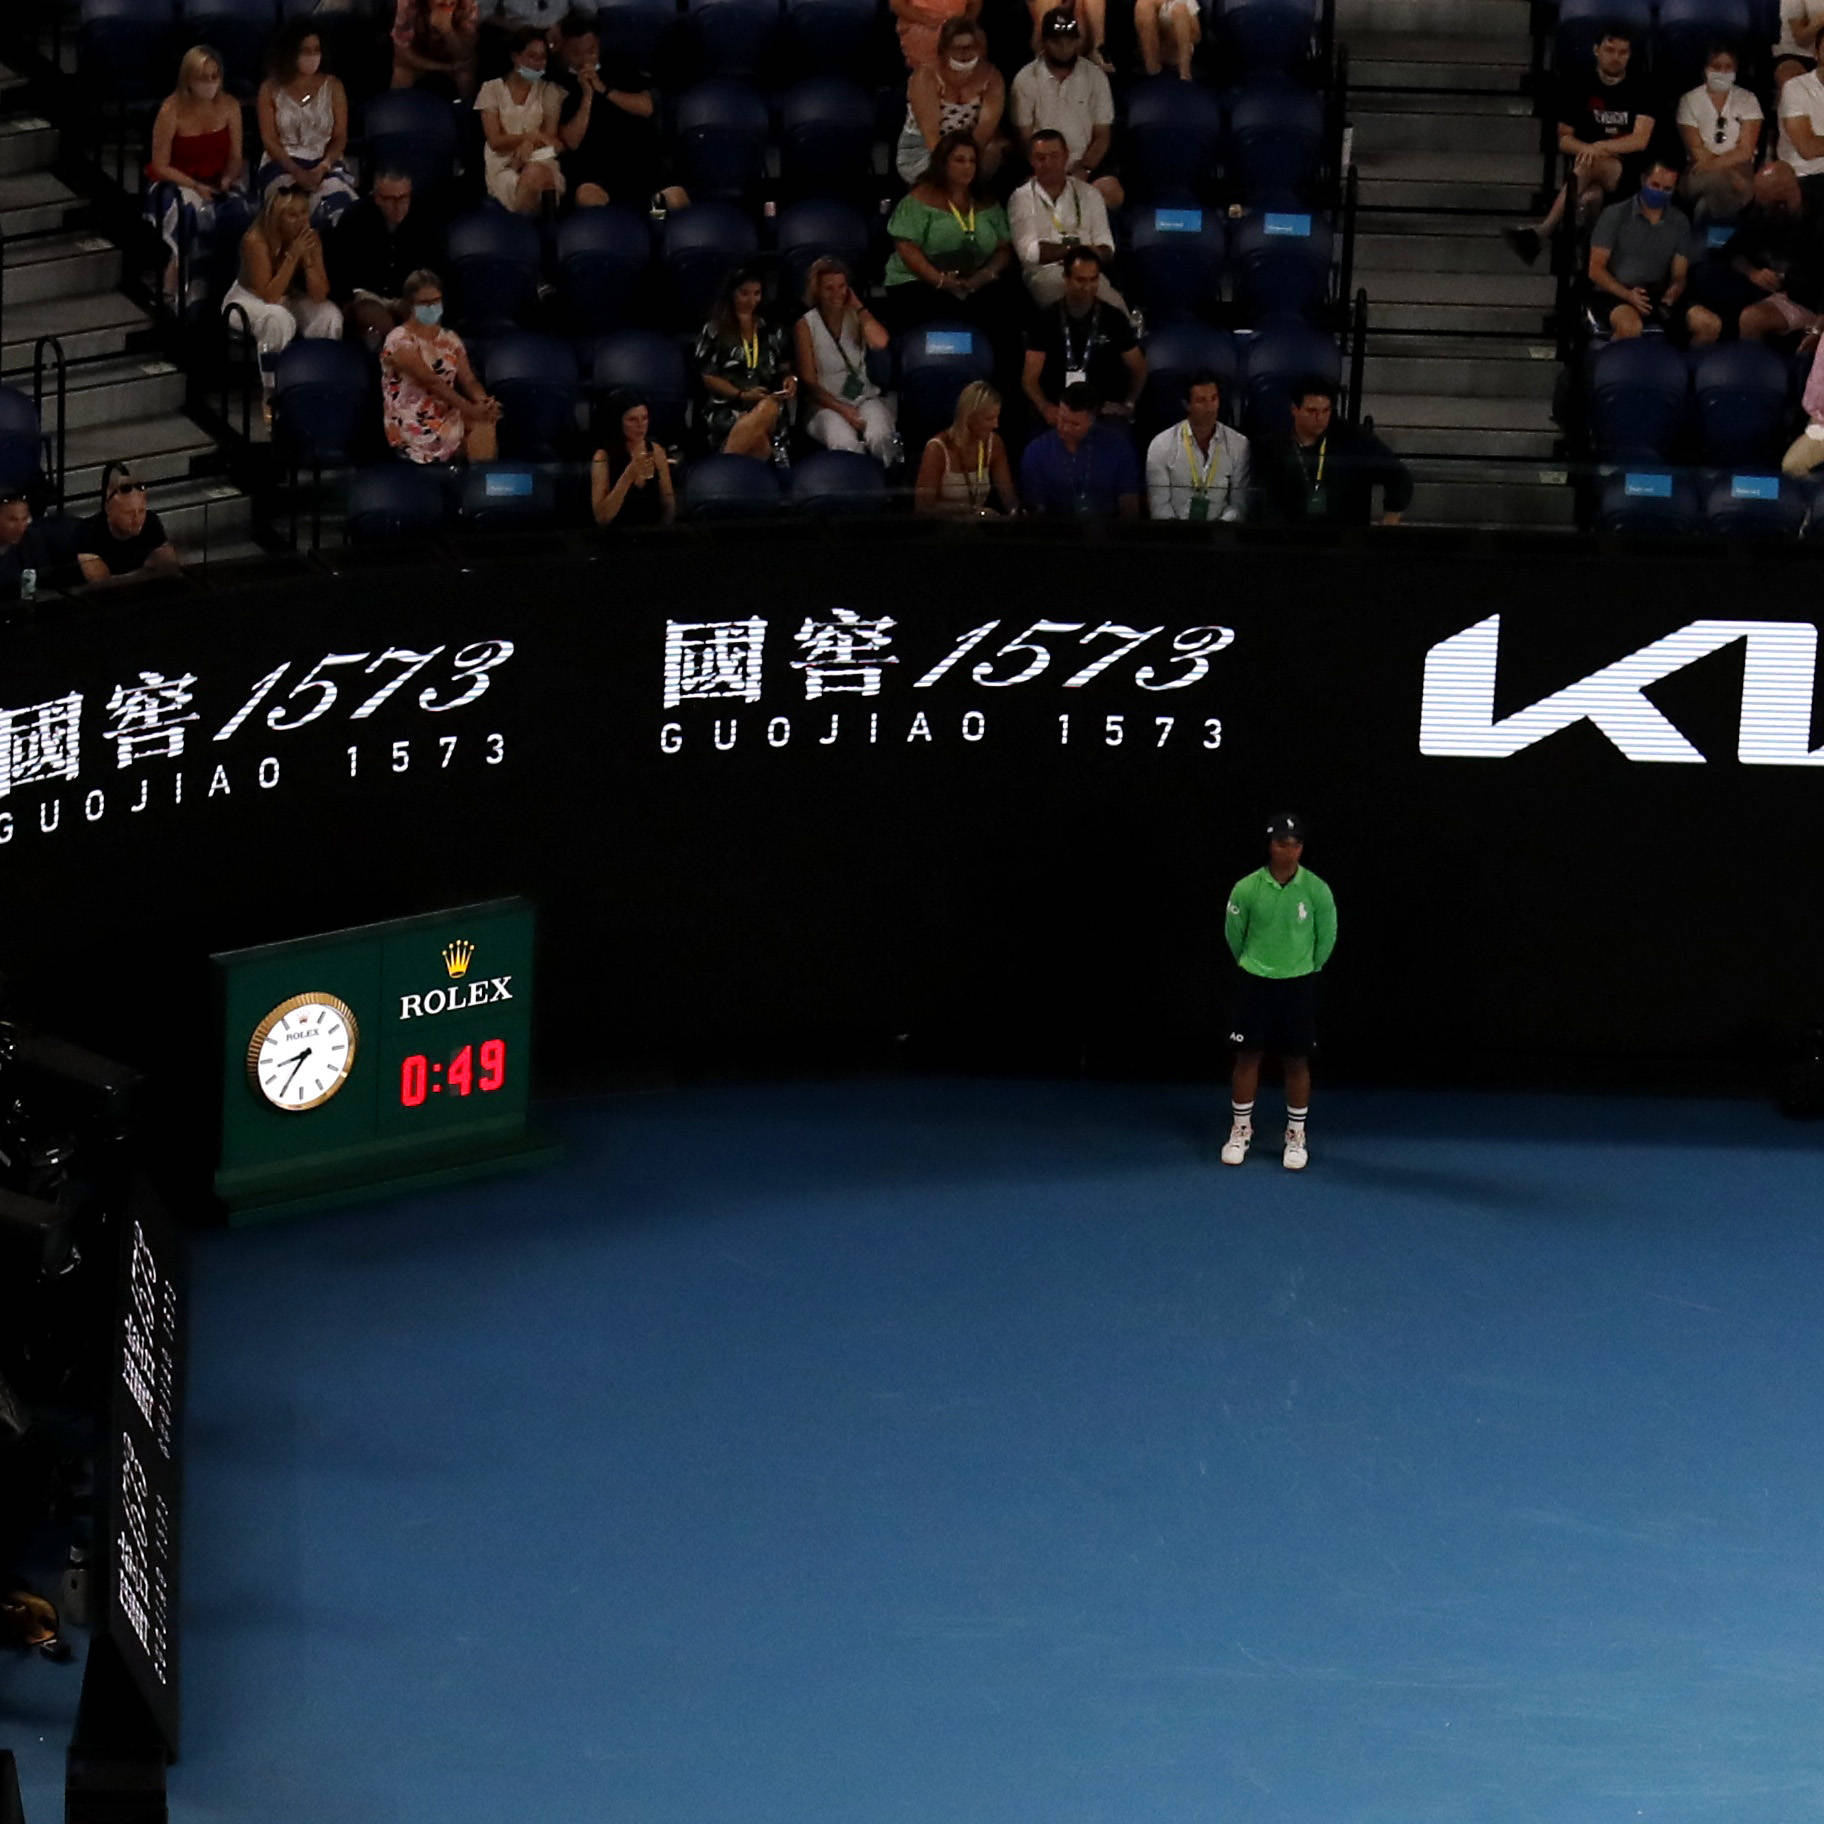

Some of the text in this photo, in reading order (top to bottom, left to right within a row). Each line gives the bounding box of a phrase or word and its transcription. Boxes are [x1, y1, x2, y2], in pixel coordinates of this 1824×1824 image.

[911, 618, 1235, 690] 1573
[212, 639, 515, 742] 1573
[660, 710, 1222, 754] GUOJIAO 1573
[347, 733, 504, 777] 1573
[399, 976, 513, 1020] ROLEX
[286, 1027, 320, 1042] ROLEX
[400, 1039, 506, 1107] 0:49
